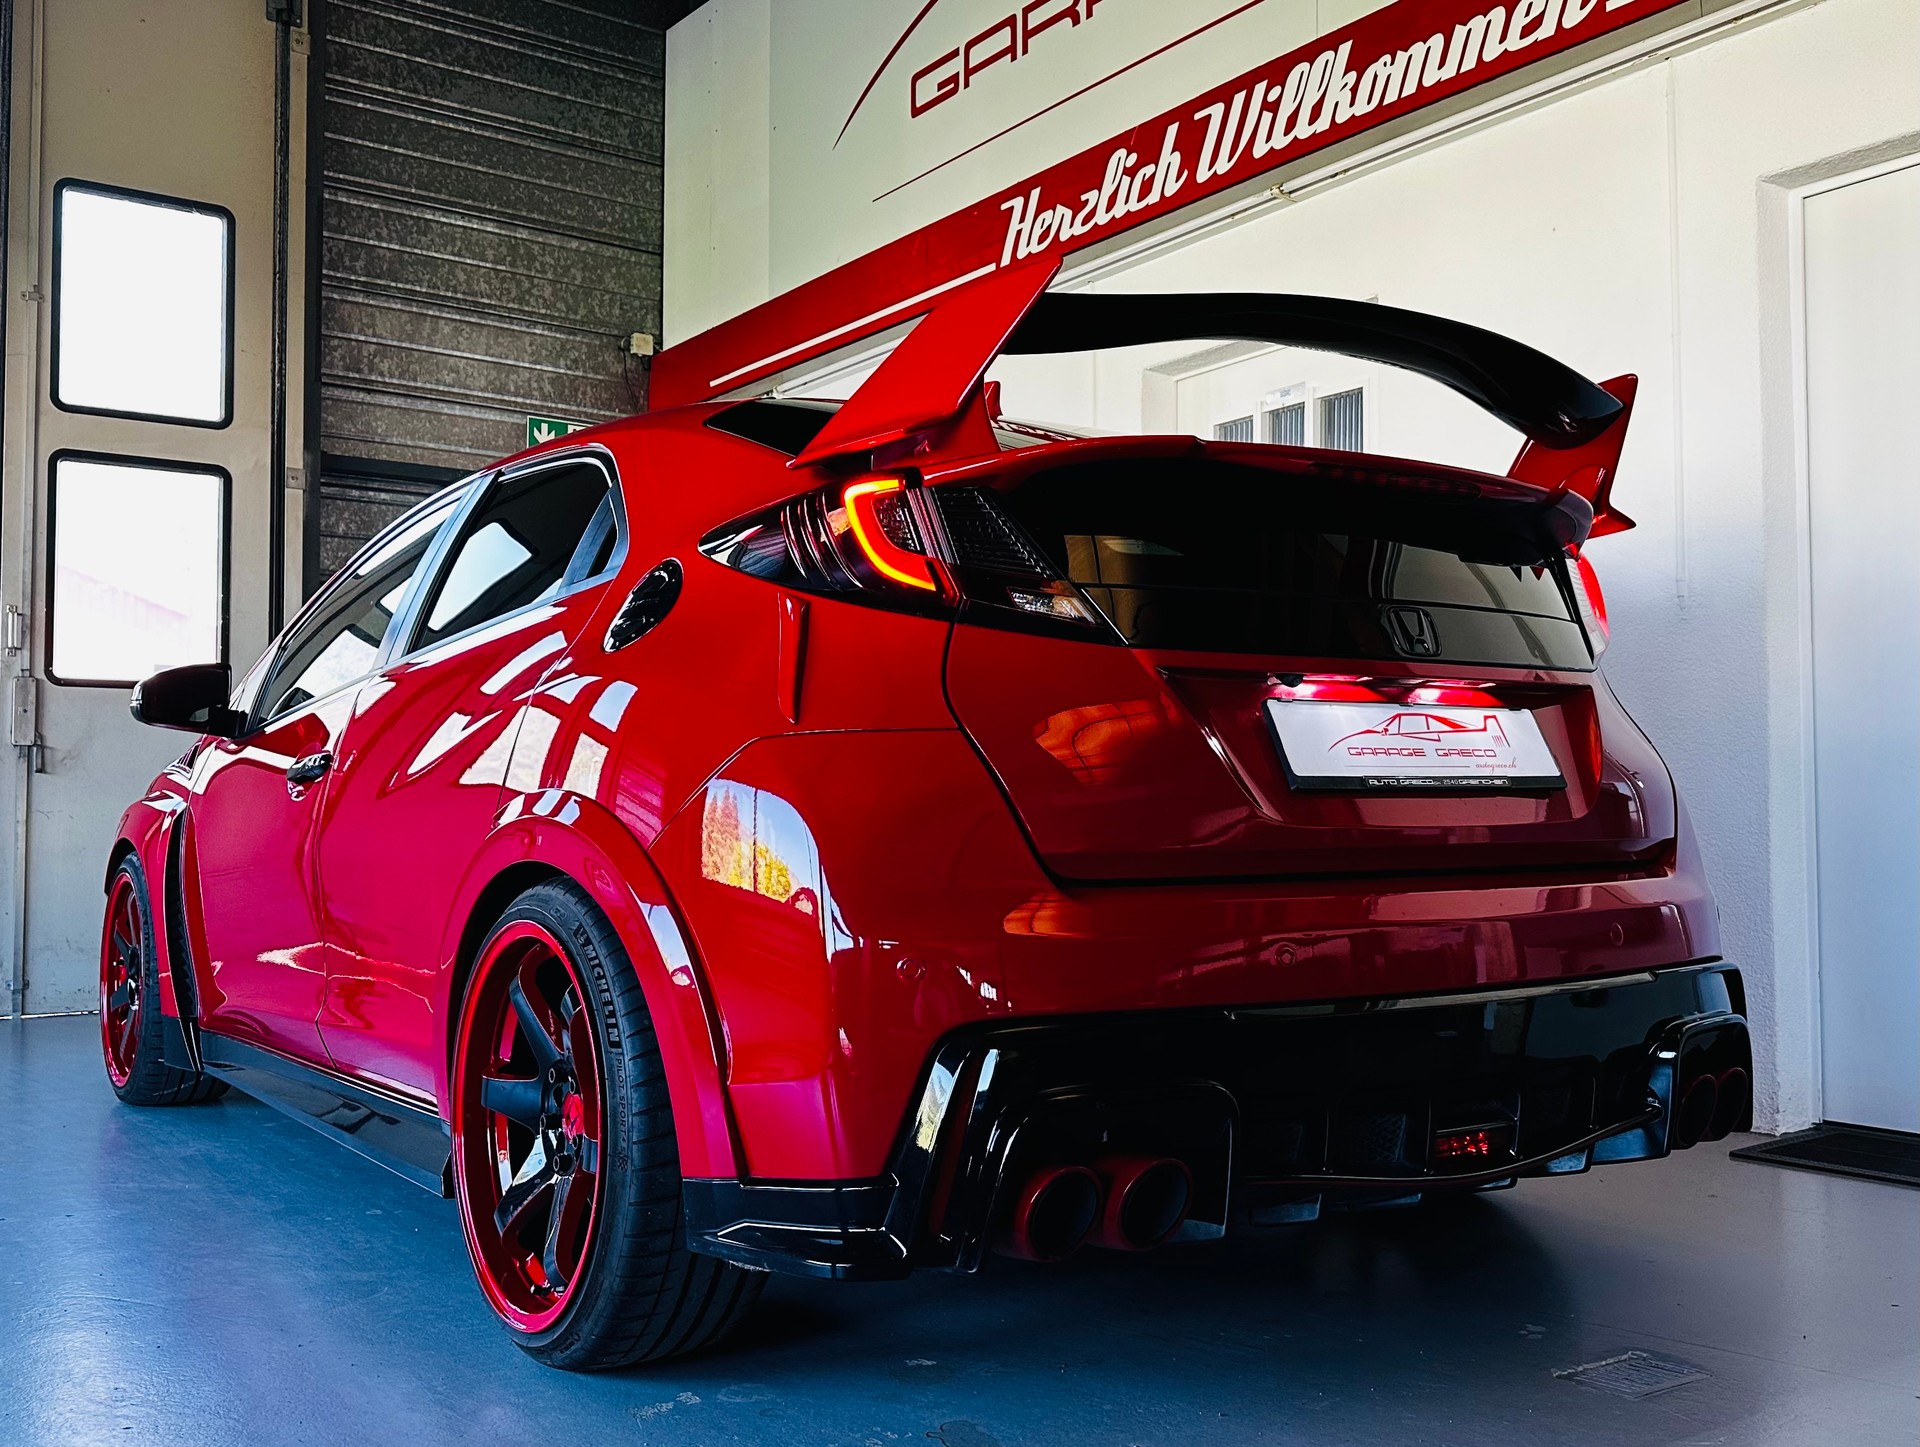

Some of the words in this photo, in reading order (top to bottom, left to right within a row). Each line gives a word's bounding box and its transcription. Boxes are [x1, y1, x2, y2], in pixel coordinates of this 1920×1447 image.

[910, 0, 1101, 119] GAR
[1000, 121, 1188, 268] Herzlich
[1193, 0, 1597, 184] Willkommen
[1347, 747, 1427, 757] GARAGE
[1435, 748, 1497, 758] GRECO
[583, 944, 620, 1042] MICHELIN
[616, 1059, 626, 1090] PILOT
[619, 1096, 627, 1136] SPORT
